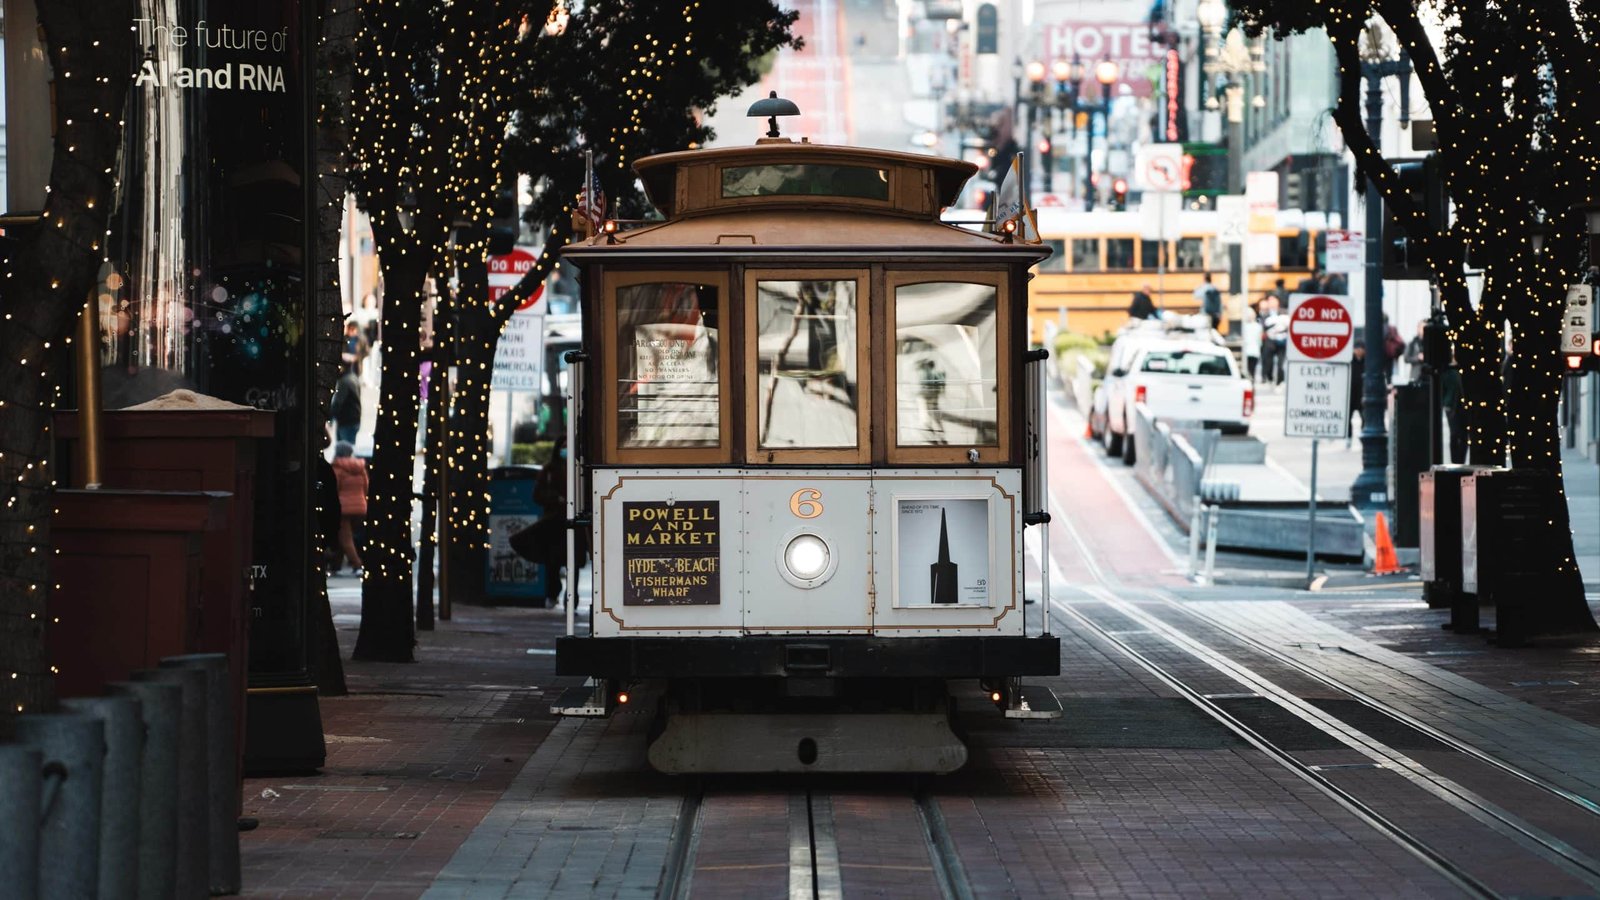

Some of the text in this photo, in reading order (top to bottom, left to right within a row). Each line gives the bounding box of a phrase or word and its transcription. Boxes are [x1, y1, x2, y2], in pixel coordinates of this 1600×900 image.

[132, 18, 288, 52] The future of
[1050, 26, 1167, 57] HOTEL
[135, 60, 286, 93] AI and RNA
[491, 260, 508, 272] DO
[1298, 307, 1344, 320] DO NOT
[1301, 335, 1338, 349] ENTER
[498, 348, 525, 358] TAXIS
[494, 362, 537, 372] MMERCIAL
[1300, 364, 1336, 376] EXCEPT
[494, 376, 533, 386] EHICLES
[1306, 381, 1329, 391] MUNI
[1304, 394, 1331, 405] TAXIS
[1289, 407, 1343, 420] COMMERCIAL
[1293, 422, 1338, 434] VEHICLES
[789, 488, 824, 519] 6
[629, 507, 715, 521] POWELL
[651, 521, 693, 531] AND
[627, 532, 716, 545] MARKET
[628, 559, 658, 573] HYDE
[677, 558, 716, 573] BEACH
[635, 575, 708, 587] FISHERMANS
[652, 587, 690, 597] WHARF
